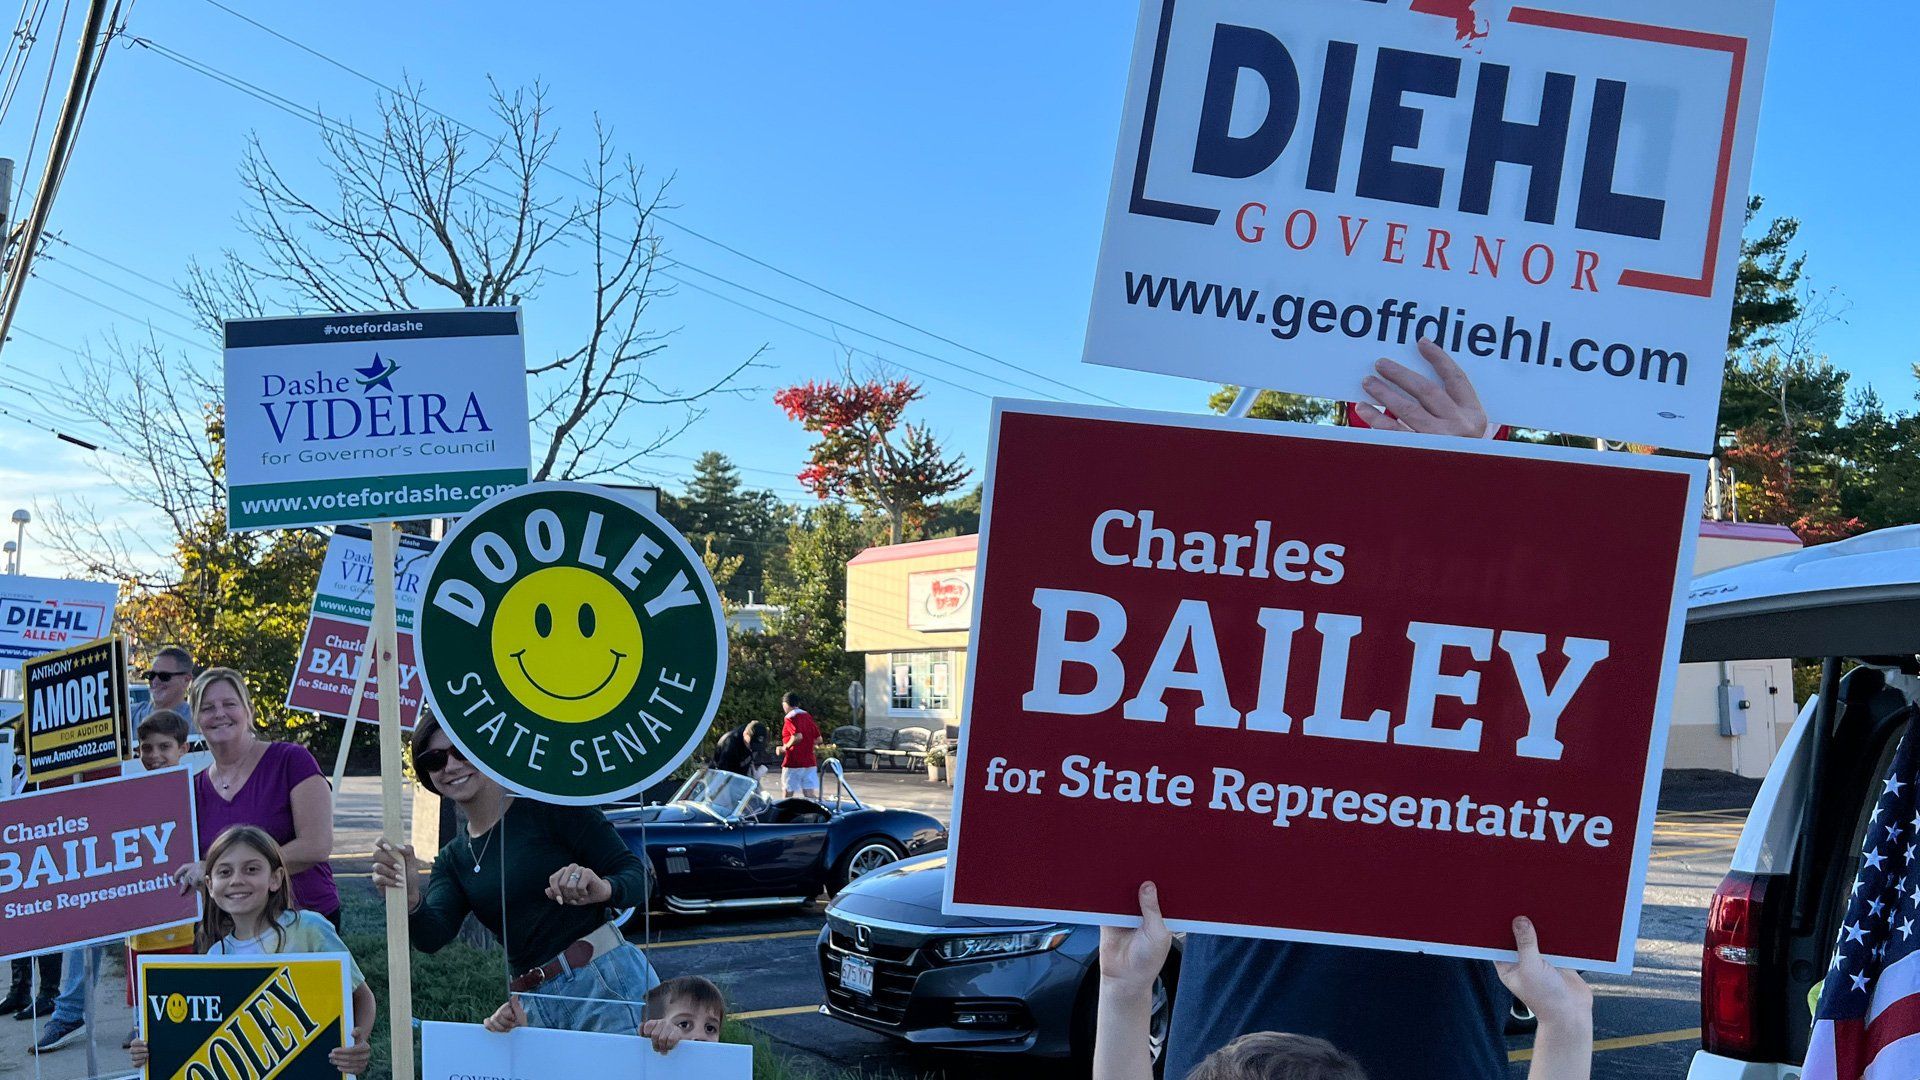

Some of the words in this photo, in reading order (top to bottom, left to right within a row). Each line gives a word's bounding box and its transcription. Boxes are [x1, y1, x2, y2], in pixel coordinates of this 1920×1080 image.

[1192, 22, 1665, 240] DIEHL
[1234, 202, 1600, 293] GOVERNOR
[324, 320, 424, 336] #votefordashe
[1123, 271, 1688, 387] www.geoffdiehl.com
[261, 370, 350, 398] Dashe
[259, 391, 493, 444] VIDEIRA
[261, 451, 292, 465] for
[298, 445, 413, 464] Governor's
[420, 439, 496, 456] Council
[433, 508, 702, 627] DOOLEY
[1090, 509, 1346, 586] Charles
[6, 606, 88, 631] DIEHL
[23, 629, 67, 642] ALLEN
[31, 659, 73, 682] ANTHONY
[311, 680, 339, 693] State
[1021, 587, 1610, 761] BAILEY
[32, 670, 111, 732] AMORE
[447, 671, 550, 771] STATE
[569, 667, 697, 776] SENATE
[31, 740, 116, 767] www.Amore2022.com
[60, 731, 75, 741] FOR
[77, 723, 109, 738] AUDITOR
[984, 757, 1047, 796] for
[1058, 754, 1195, 808] State
[1209, 766, 1614, 848] Representative
[3, 816, 90, 844] Charles
[0, 821, 177, 893] BAILEY
[4, 900, 53, 919] State
[57, 873, 178, 909] Representativ
[148, 992, 223, 1024] VOTE
